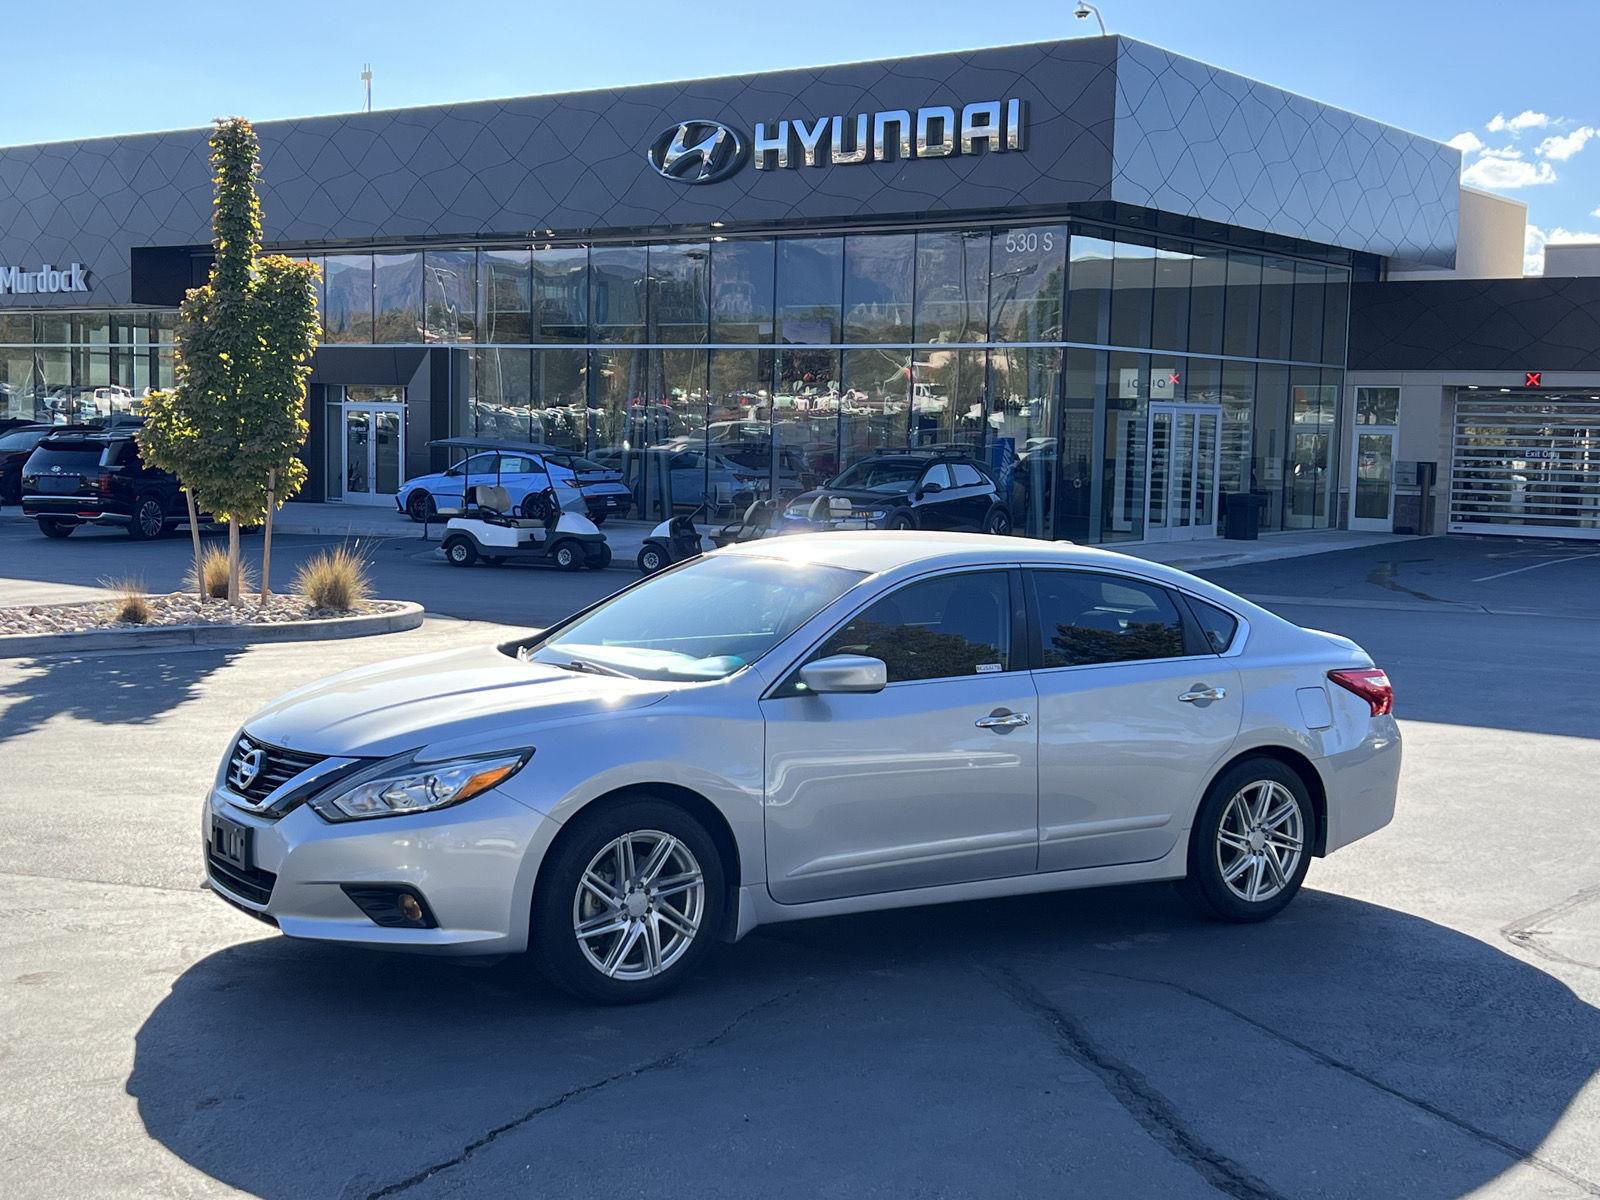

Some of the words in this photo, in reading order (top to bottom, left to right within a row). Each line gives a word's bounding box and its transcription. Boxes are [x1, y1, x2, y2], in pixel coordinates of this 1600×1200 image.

[754, 98, 1021, 170] HYUNDAI
[1005, 233, 1037, 252] 530
[1043, 232, 1053, 251] S
[0, 263, 88, 294] Murdock
[1127, 379, 1166, 388] IOIQ
[1525, 450, 1541, 458] Exit
